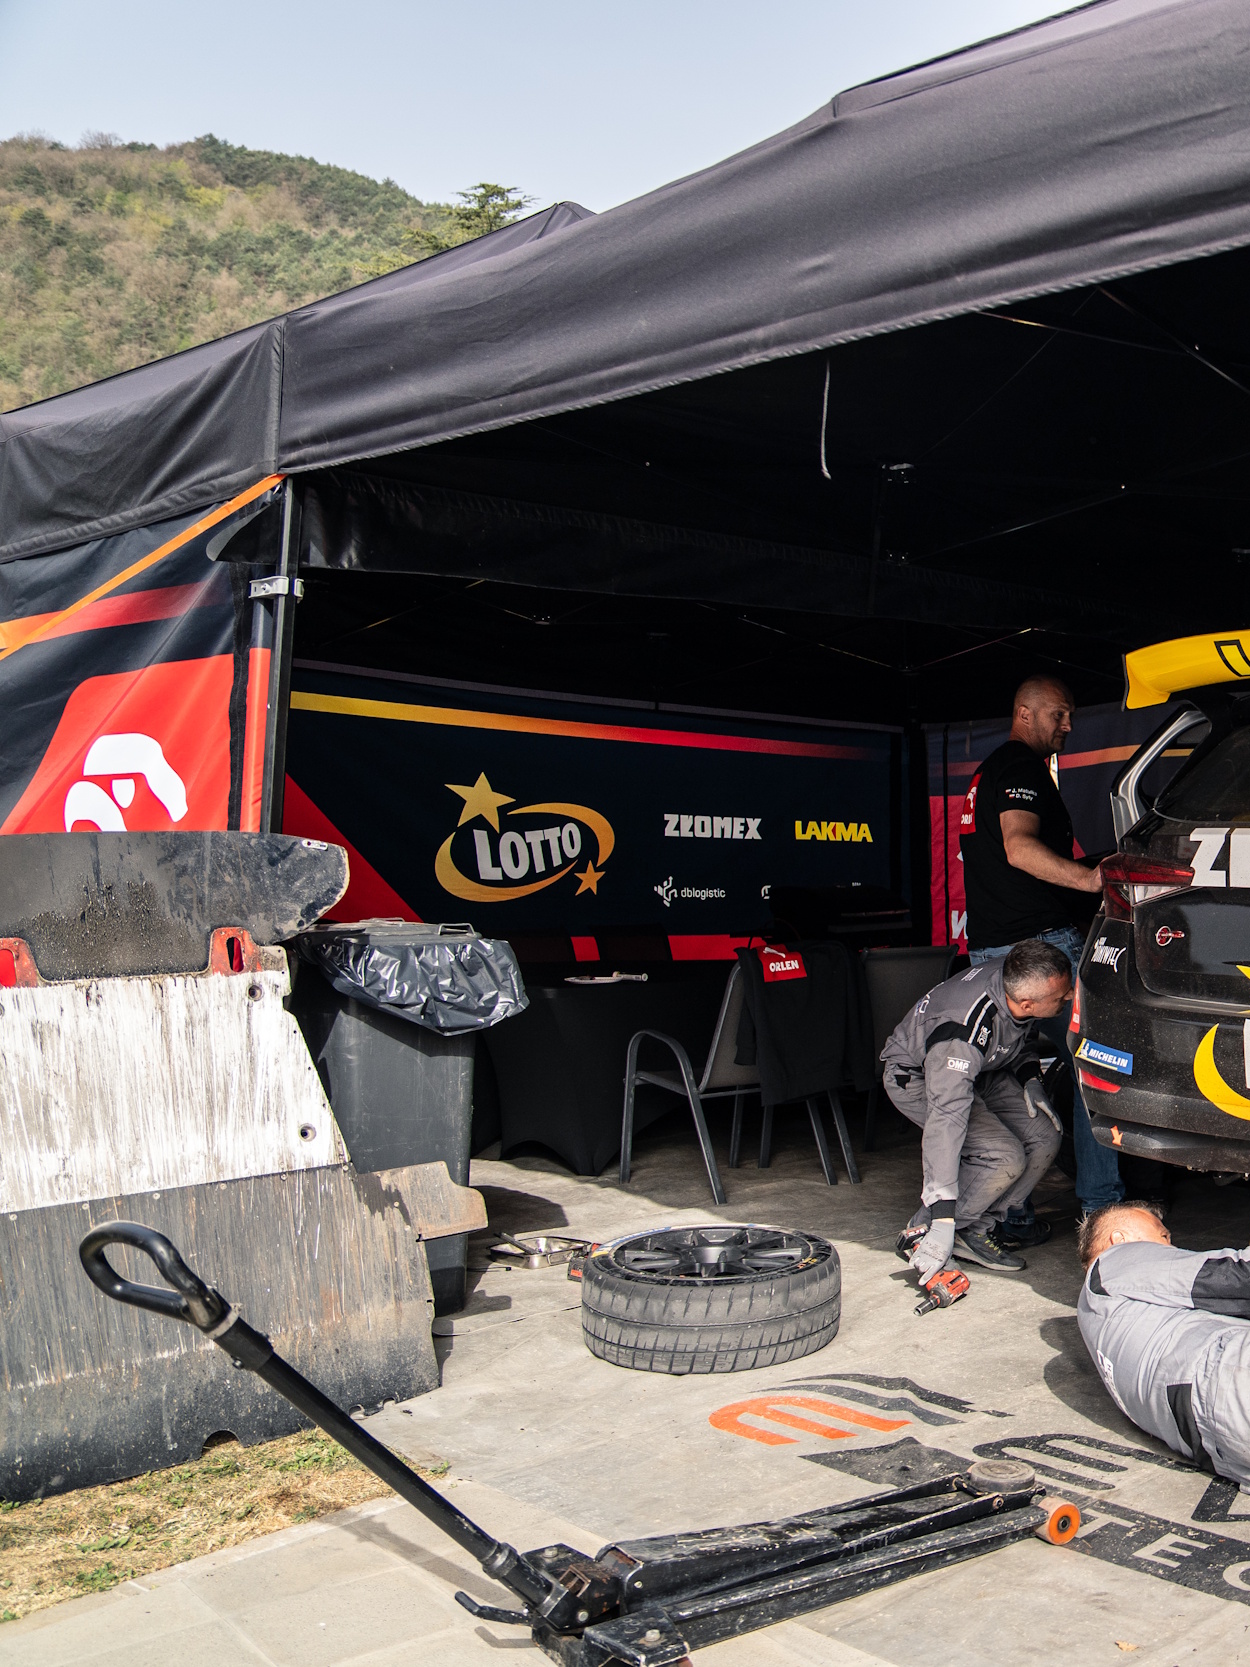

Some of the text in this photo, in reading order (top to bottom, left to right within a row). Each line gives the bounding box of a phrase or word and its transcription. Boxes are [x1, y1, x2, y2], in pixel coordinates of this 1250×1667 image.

[794, 819, 874, 843] LAKMA
[473, 821, 582, 881] LOTTO
[680, 887, 726, 900] dblogistic
[769, 959, 800, 973] ORLEN
[947, 1059, 970, 1071] OMP
[1088, 1048, 1129, 1068] MICHELIN
